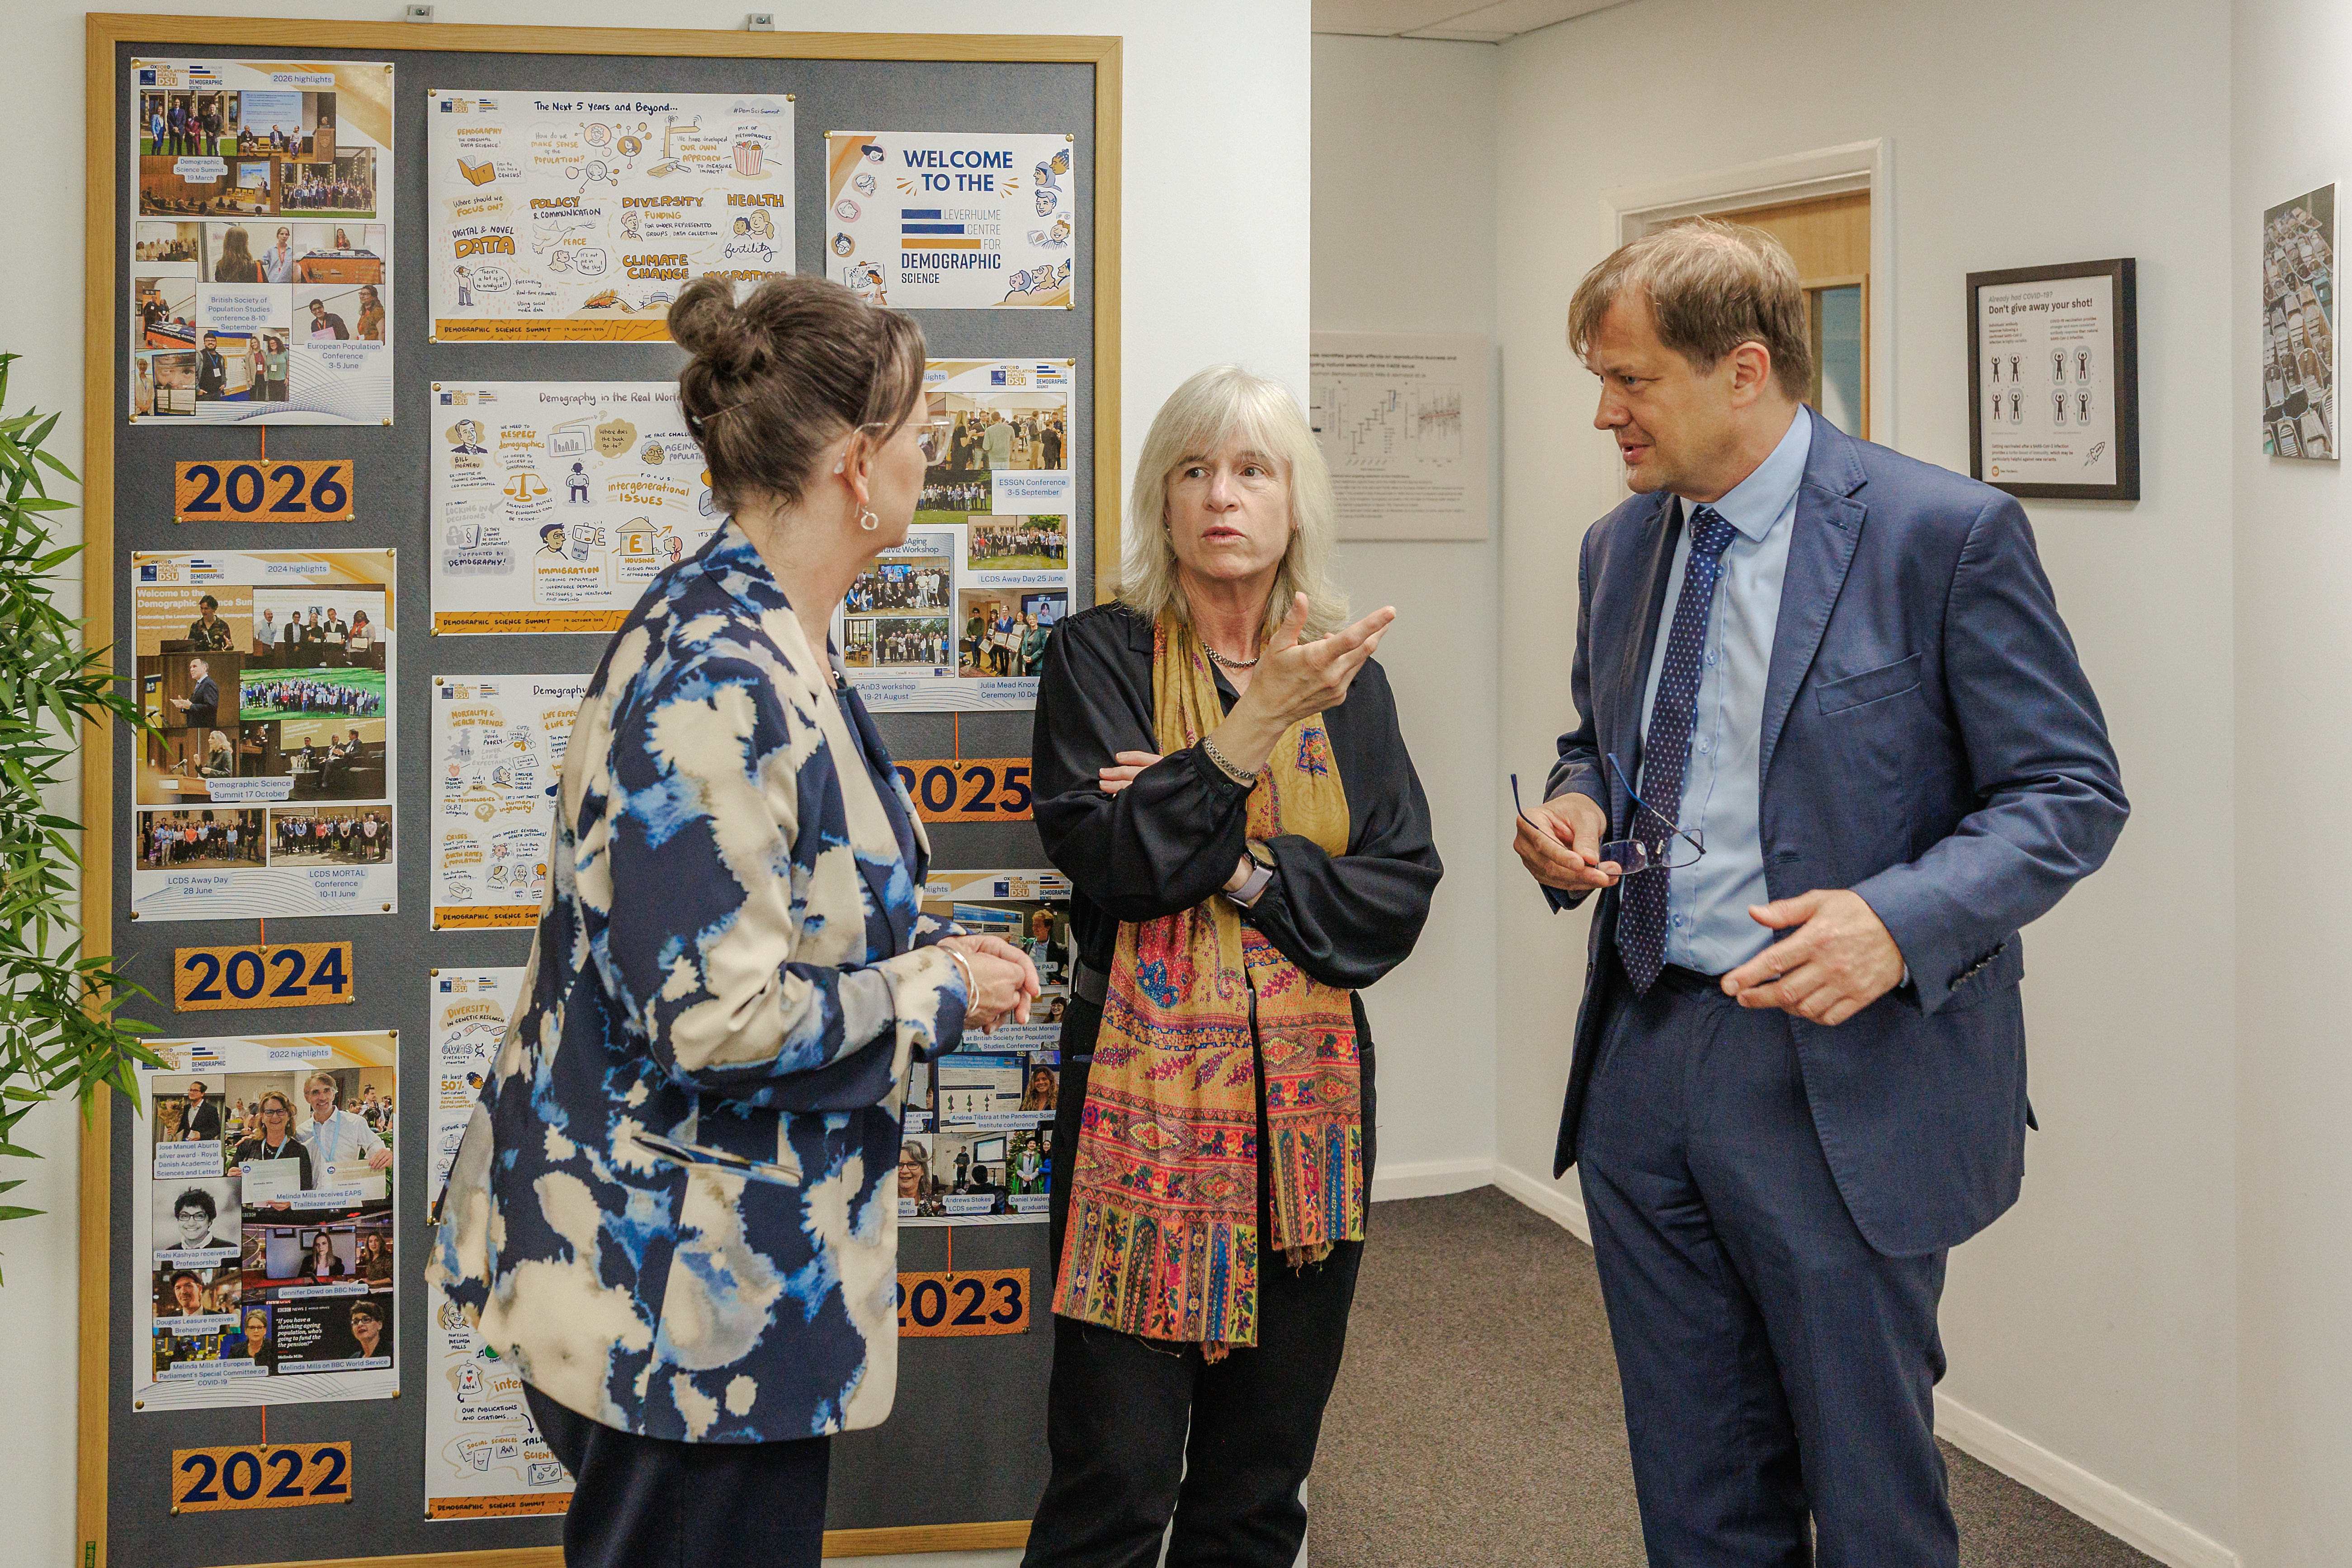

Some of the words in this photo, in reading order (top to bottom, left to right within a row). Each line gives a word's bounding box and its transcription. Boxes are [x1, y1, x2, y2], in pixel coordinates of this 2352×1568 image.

[295, 76, 331, 84] highlights
[534, 101, 549, 110] The
[553, 103, 572, 111] Next
[636, 102, 677, 116] Beyond...
[534, 155, 585, 164] POPULATION?
[683, 154, 720, 162] APPROACH
[903, 151, 1012, 168] WELCOME
[921, 174, 950, 191] TO
[955, 175, 993, 191] THE
[474, 195, 491, 204] should
[530, 196, 580, 209] POLICY
[622, 196, 704, 208] DIVERSITY
[727, 194, 784, 207] HEALTH
[457, 205, 484, 217] FOCUS
[541, 208, 600, 218] COMMUNICATION
[645, 211, 681, 219] FUNDING
[945, 209, 1001, 220] LEVERHULME
[452, 227, 478, 238] DIGITAL
[968, 224, 1001, 235] CENTRE
[454, 235, 515, 259] DATA
[984, 239, 1001, 250] FOR
[723, 242, 778, 262] fertility
[623, 254, 689, 267] CLIMATE
[902, 253, 1000, 269] DEMOGRAPHIC
[627, 267, 689, 281] CHANGE
[902, 273, 939, 283] SCIENCE
[1988, 295, 2009, 303] Already
[2023, 291, 2053, 300] COVID-19?
[1989, 305, 2009, 314] Don't
[2012, 303, 2026, 315] give
[2029, 304, 2049, 312] away
[2052, 302, 2069, 312] your
[2072, 298, 2092, 308] shot!
[540, 392, 596, 406] Demography
[601, 393, 609, 401] in
[613, 392, 627, 401] the
[631, 392, 650, 401] Real
[499, 440, 544, 451] demographics
[184, 465, 346, 513] 2026
[609, 482, 689, 496] intergenerational
[620, 493, 662, 505] ISSUES
[449, 558, 505, 567] DEMOGRAPHY!
[452, 710, 487, 719] MORTALITY
[453, 718, 475, 727] HEALTH
[184, 948, 348, 1001] 2024
[448, 1005, 489, 1018] DIVERSITY
[291, 1050, 328, 1058] highlights
[442, 1044, 473, 1054] GWAS
[897, 1277, 1023, 1327] 023
[180, 1447, 347, 1503] 2022
